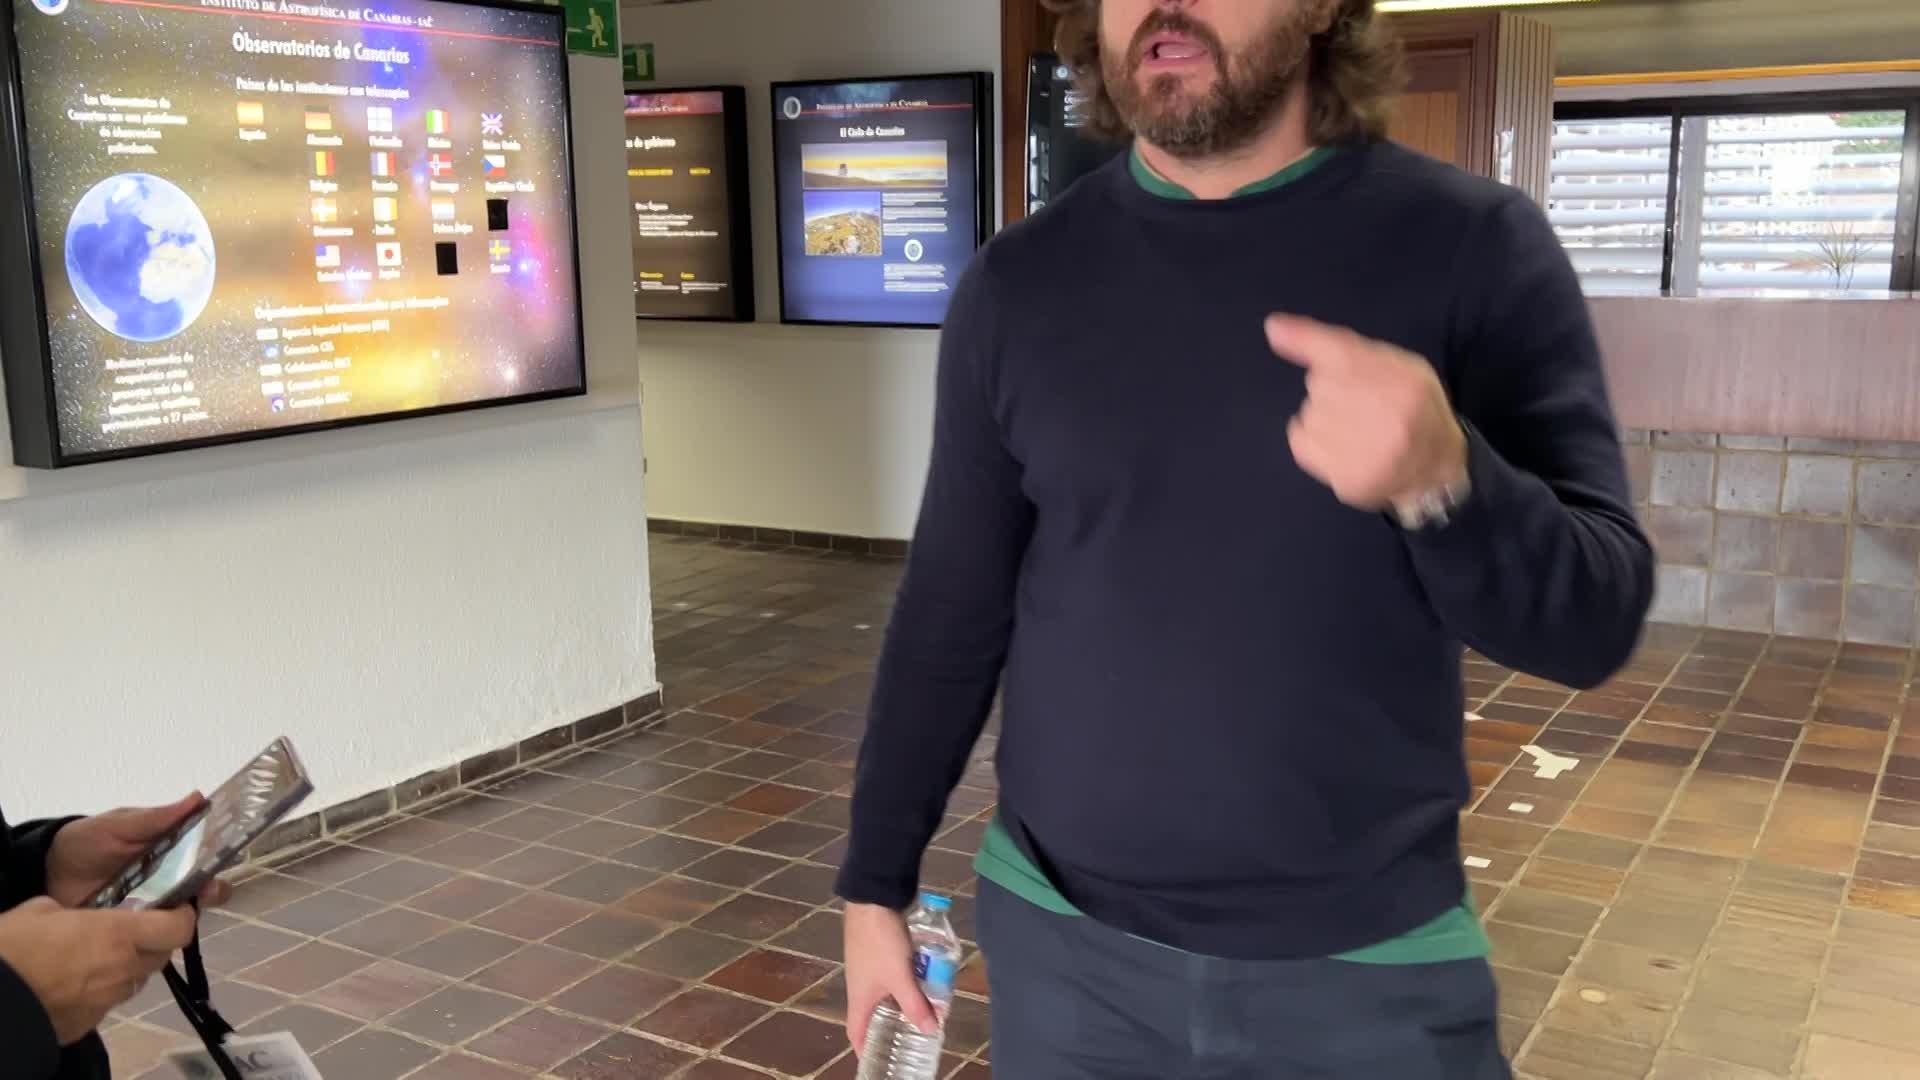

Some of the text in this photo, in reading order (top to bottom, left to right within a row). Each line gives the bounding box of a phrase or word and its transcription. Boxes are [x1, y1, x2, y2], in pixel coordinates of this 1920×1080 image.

[232, 31, 411, 65] Observatorios de Canarias
